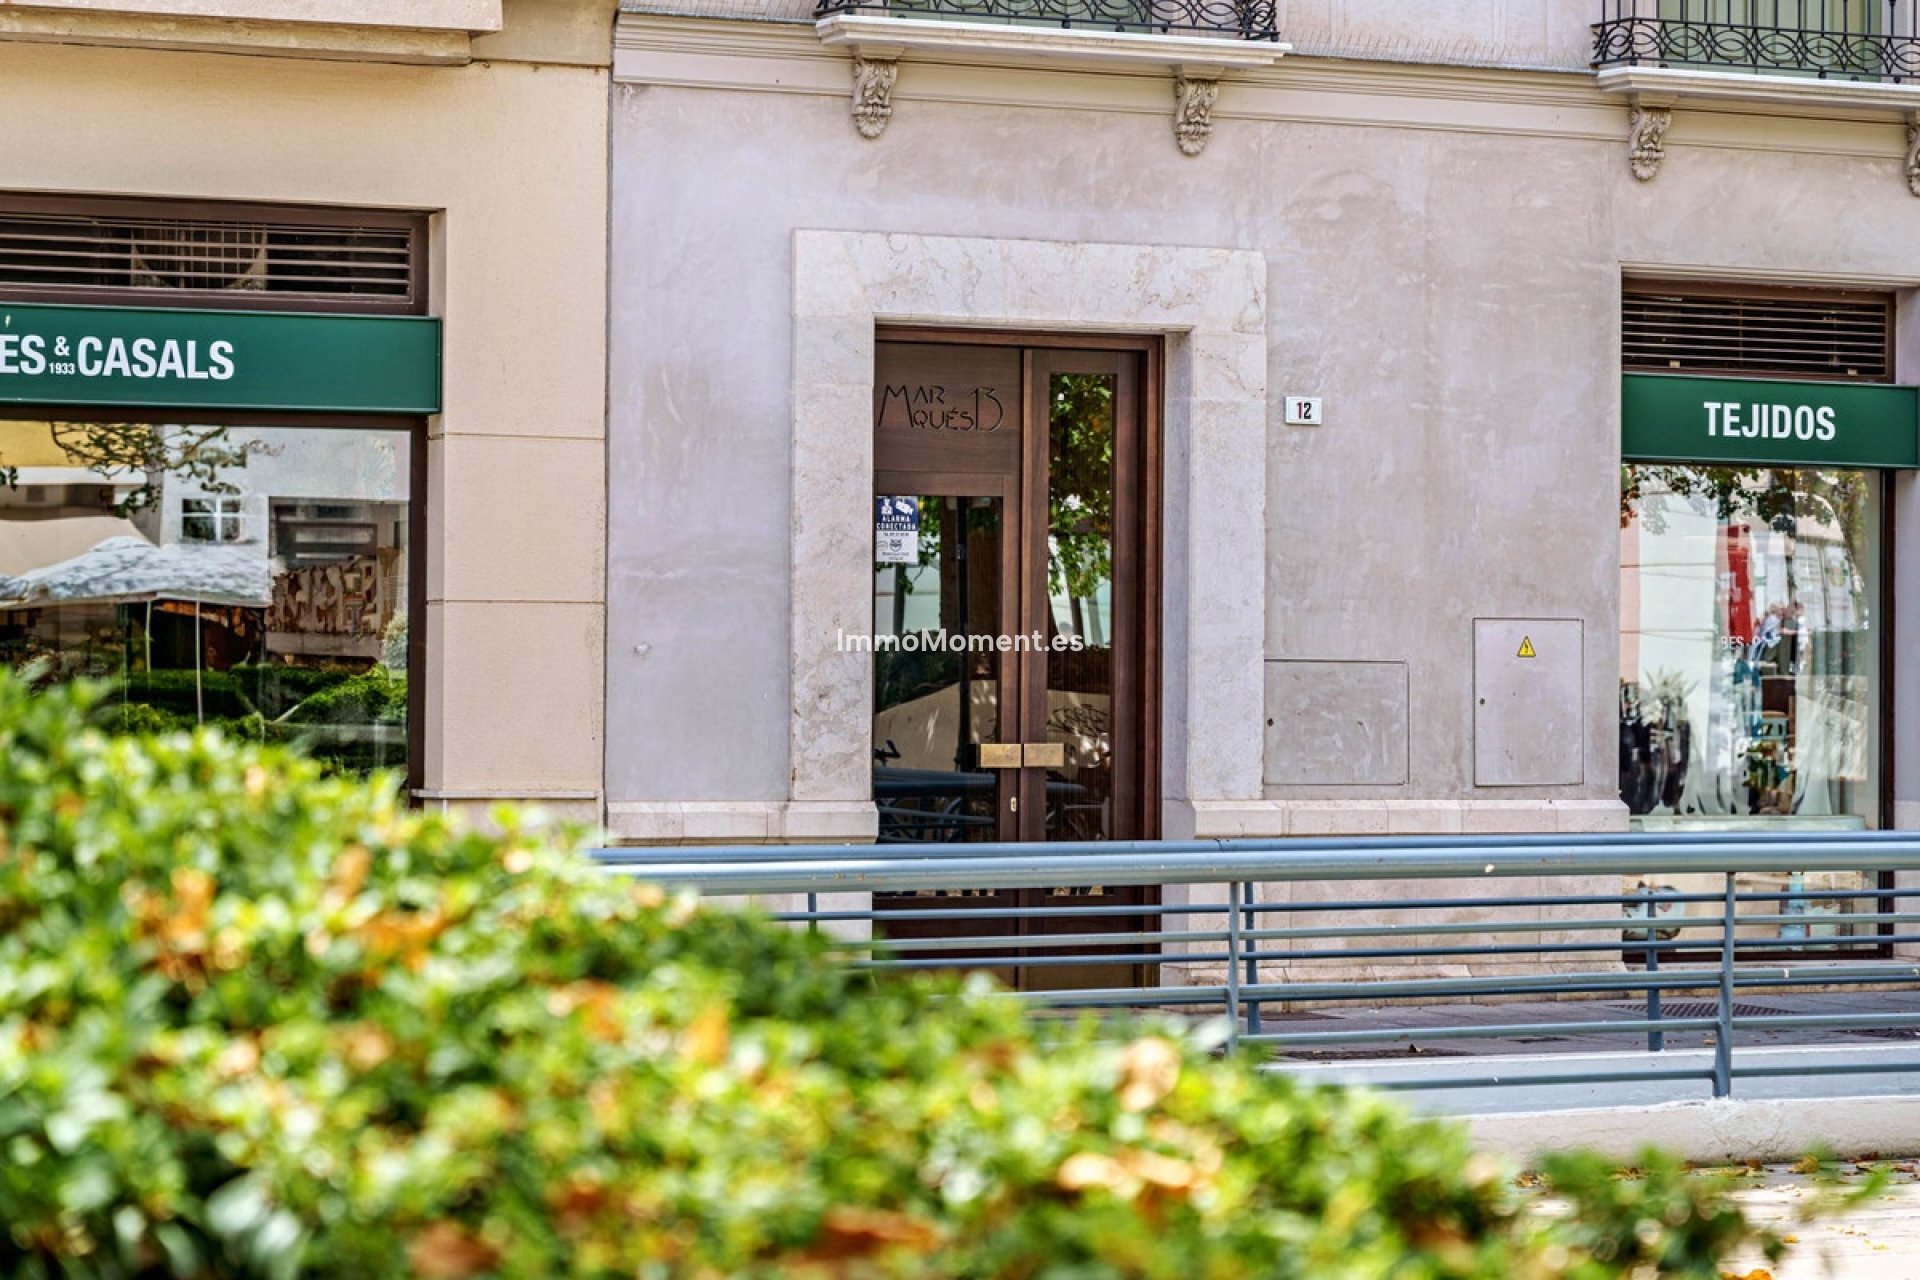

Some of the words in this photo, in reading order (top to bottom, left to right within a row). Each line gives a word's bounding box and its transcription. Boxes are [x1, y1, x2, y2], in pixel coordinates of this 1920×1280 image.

[49, 362, 76, 375] 1933
[54, 335, 70, 356] &
[77, 336, 235, 380] CASALS
[1296, 401, 1312, 420] 12
[1703, 401, 1836, 441] TEJIDOS
